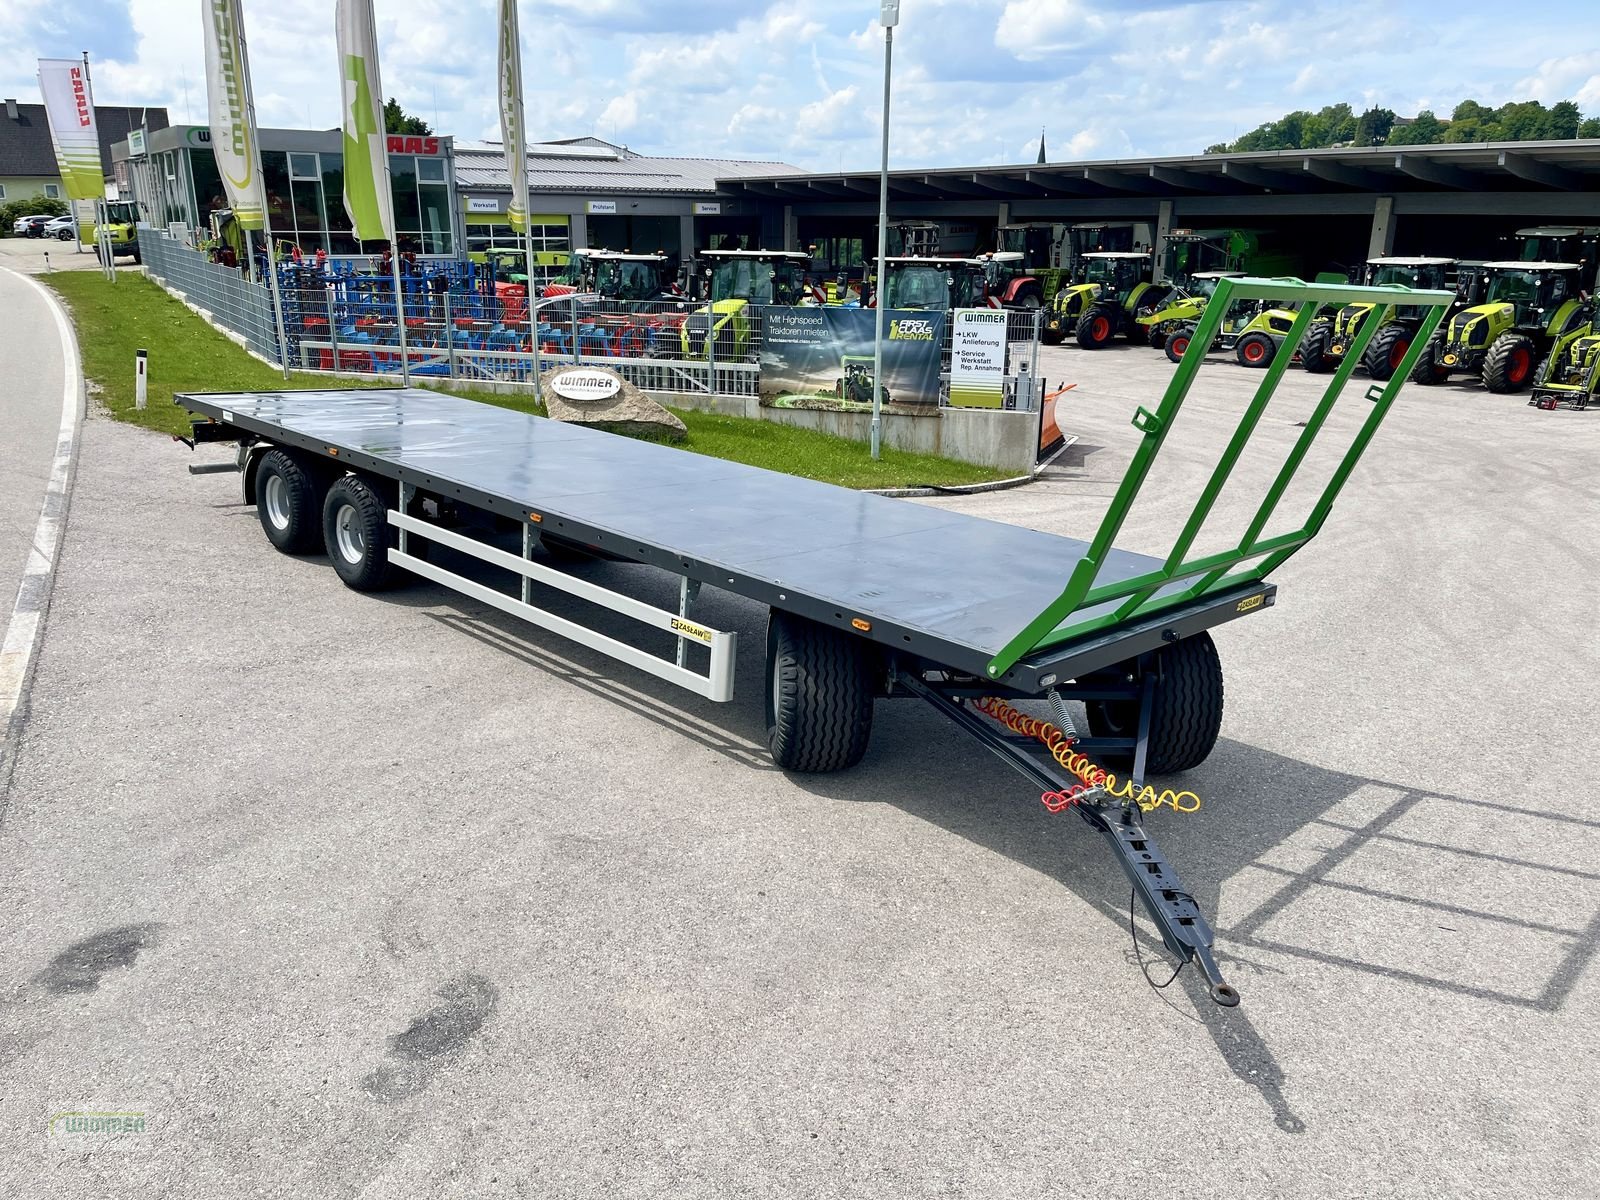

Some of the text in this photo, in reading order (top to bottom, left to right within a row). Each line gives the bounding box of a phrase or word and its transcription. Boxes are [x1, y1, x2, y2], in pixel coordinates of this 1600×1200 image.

[387, 136, 438, 154] AAS
[769, 315, 823, 325] Mit Highspeed
[964, 313, 1005, 323] WIMMER
[899, 319, 929, 327] FIRST
[769, 326, 802, 336] Traktoren
[898, 326, 933, 334] CLAAS
[895, 333, 935, 341] RENTAL
[961, 338, 1000, 347] Anlieferung
[960, 364, 973, 372] Rep.
[560, 376, 613, 388] WIMMER
